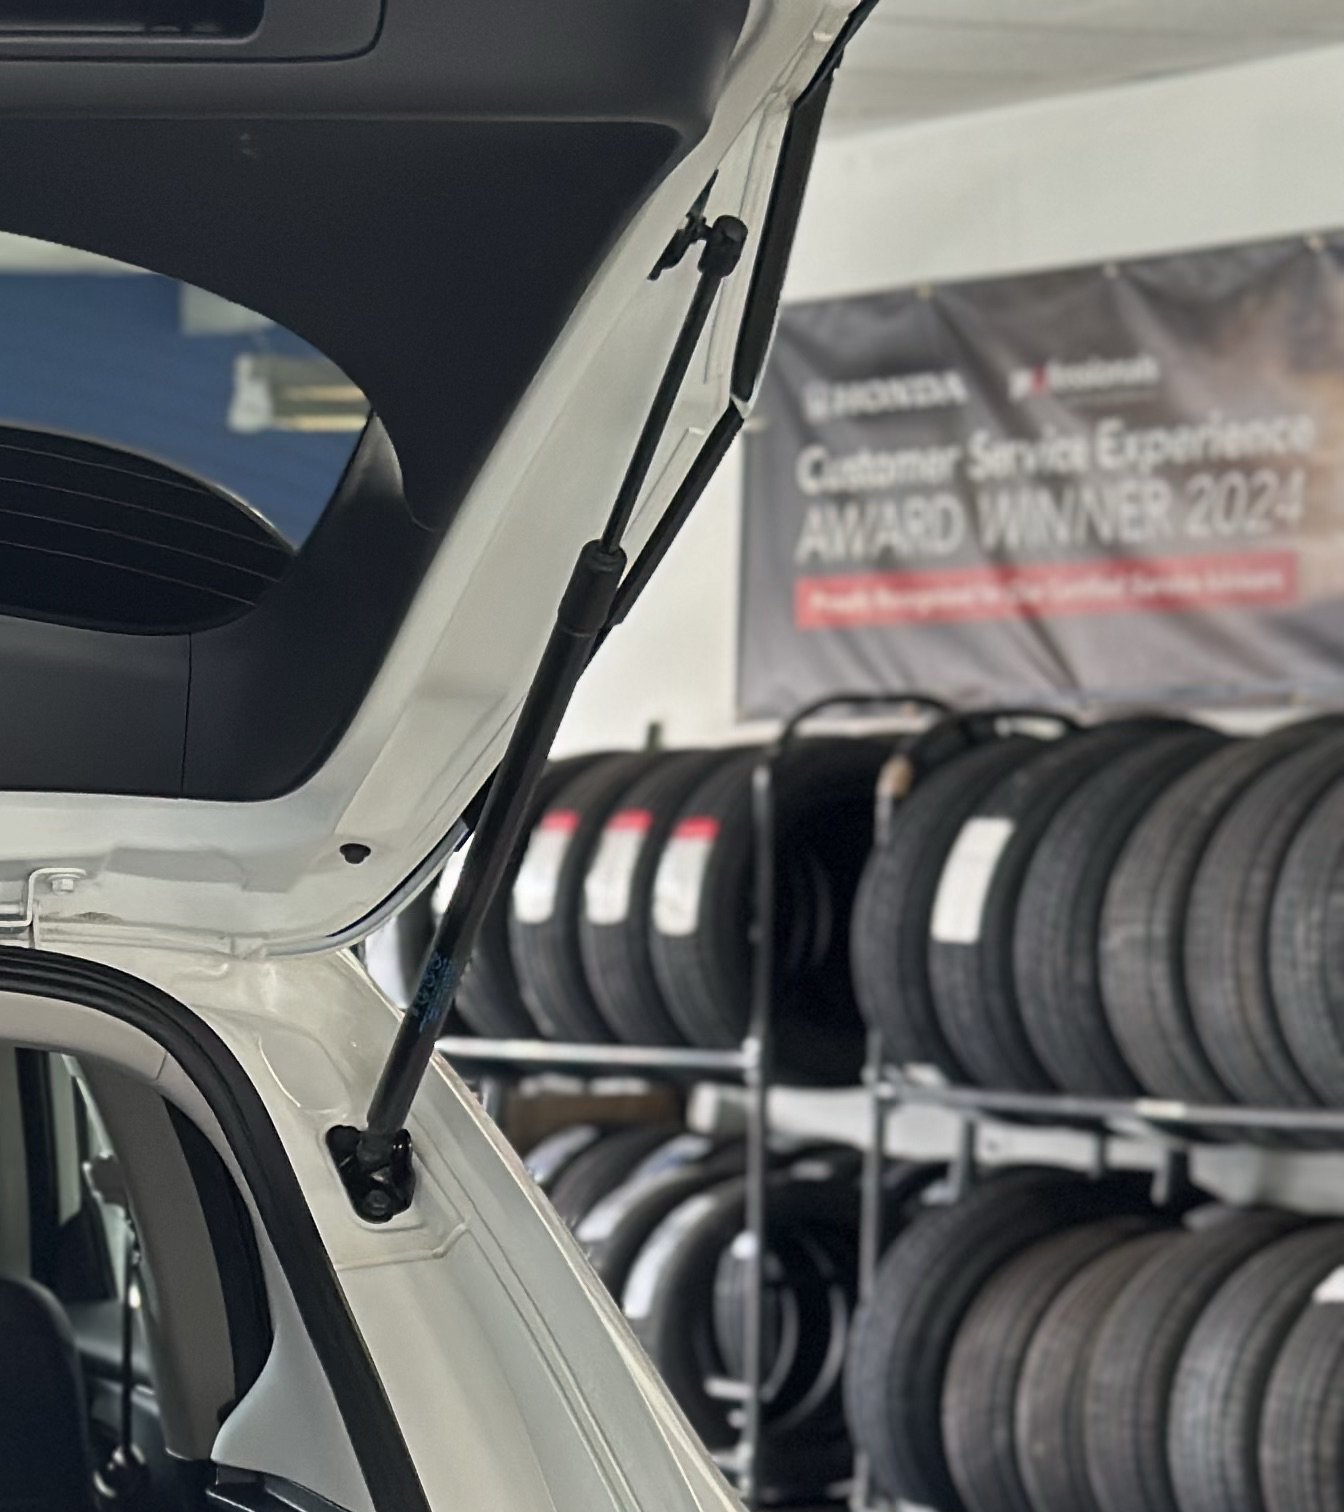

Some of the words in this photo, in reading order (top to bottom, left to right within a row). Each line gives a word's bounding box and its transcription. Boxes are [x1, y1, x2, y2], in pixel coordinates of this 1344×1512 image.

[831, 371, 968, 416] HONDA
[796, 446, 960, 496] Customer
[967, 428, 1090, 481] Service
[1095, 411, 1314, 475] Experience
[795, 493, 964, 565] AWARD
[976, 477, 1175, 548] WINNER
[1184, 467, 1306, 537] 2024
